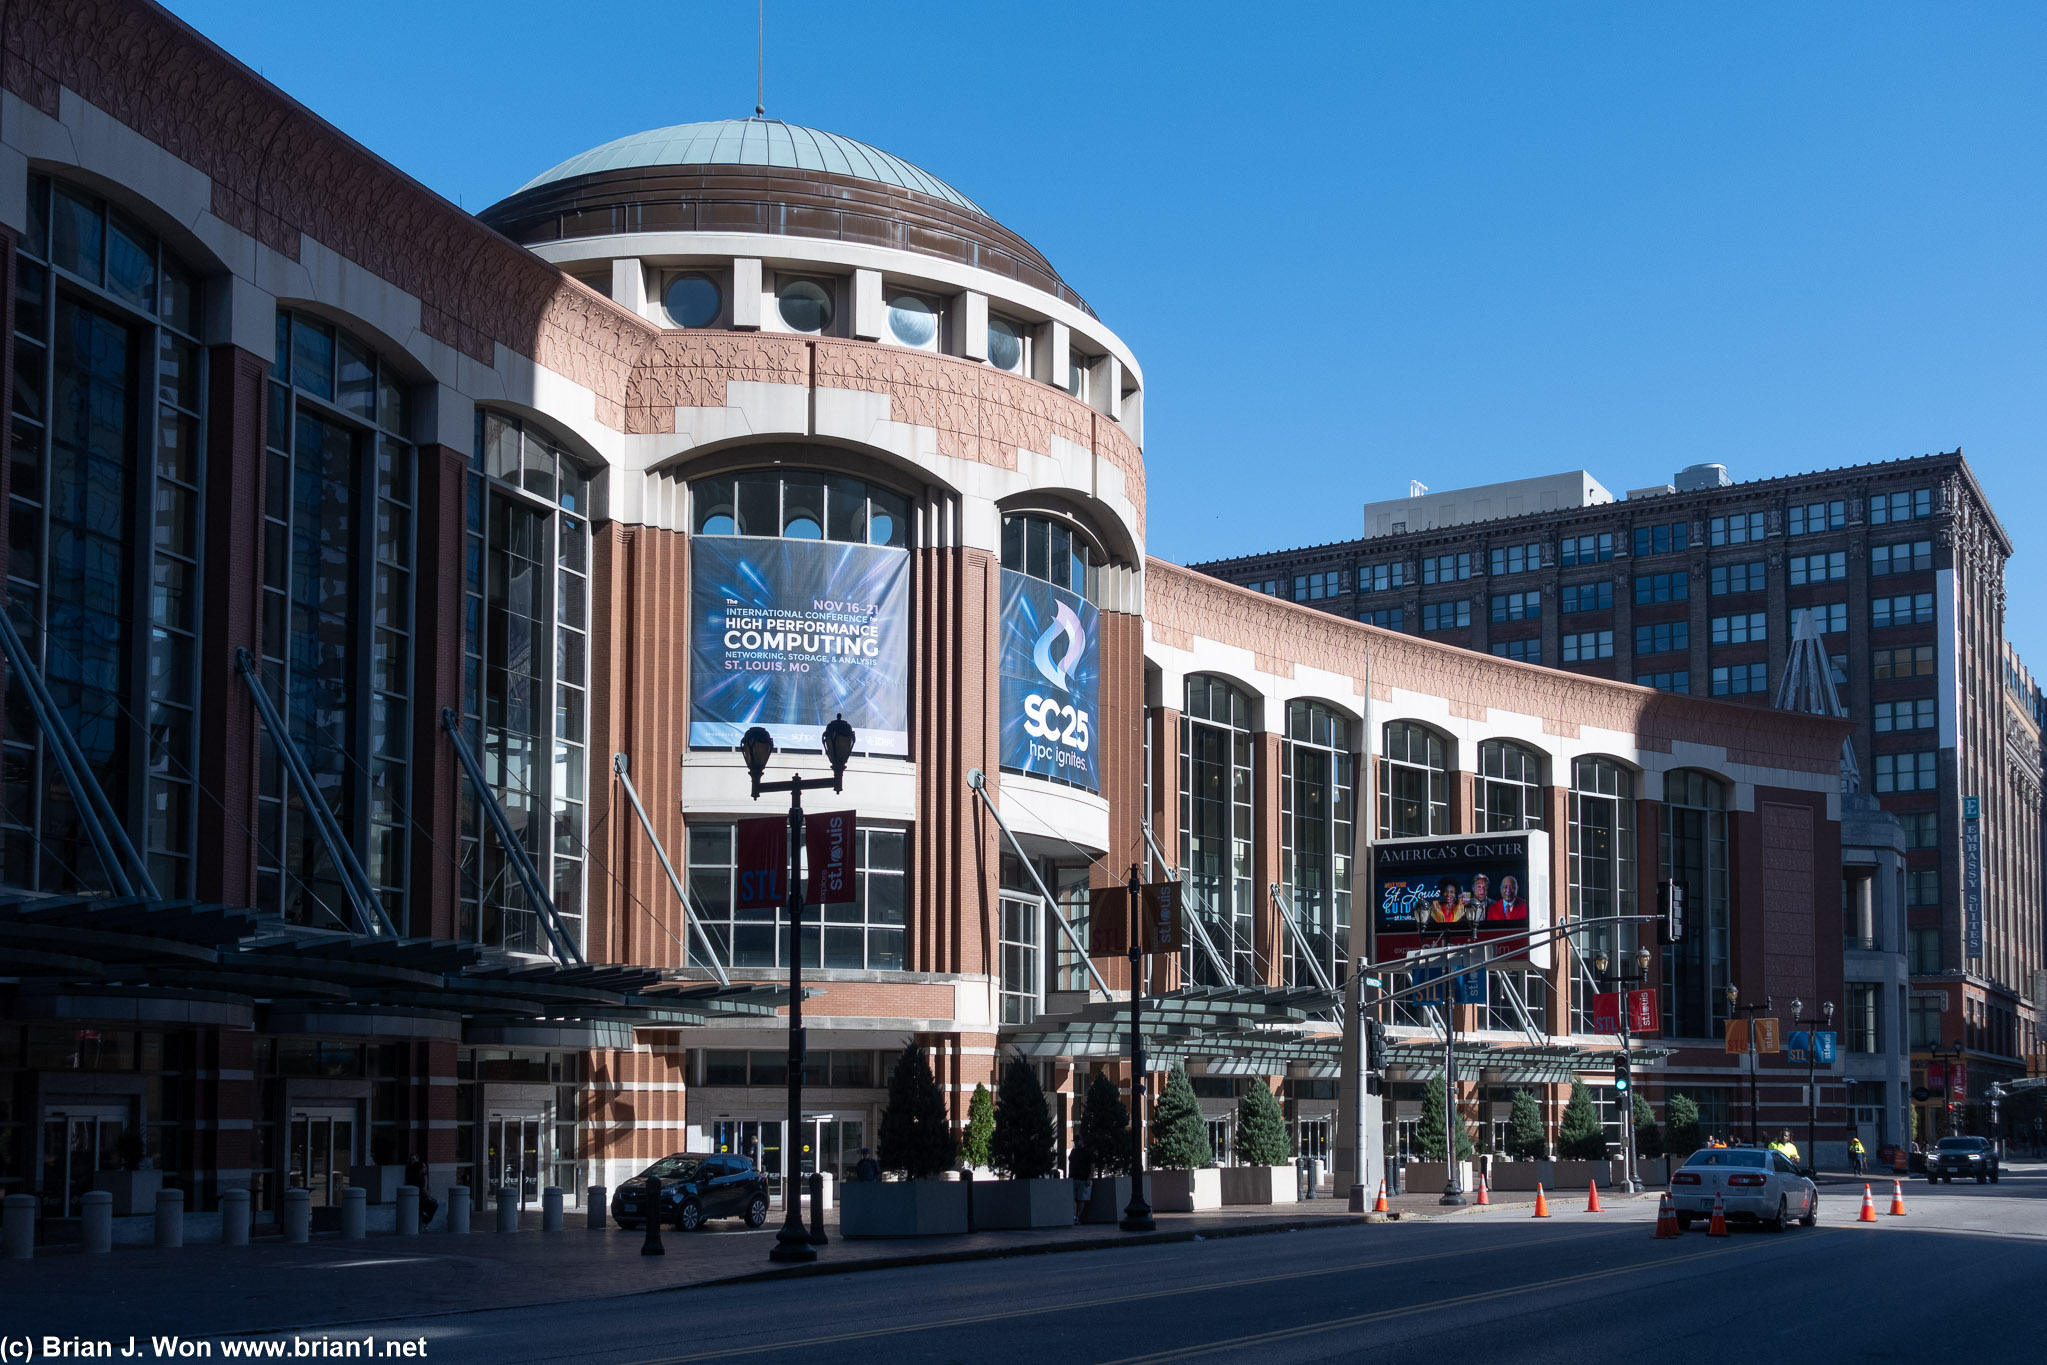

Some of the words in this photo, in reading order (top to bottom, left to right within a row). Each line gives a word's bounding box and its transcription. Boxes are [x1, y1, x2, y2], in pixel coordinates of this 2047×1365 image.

[814, 600, 843, 611] NOV
[726, 608, 803, 618] INTERNATIONAL
[805, 611, 868, 623] CONFERENCE
[725, 618, 762, 629] HIGH
[766, 619, 879, 637] PERFORMANCE
[724, 631, 879, 657] COMPUTING
[725, 651, 786, 660] NETWORKING,
[788, 653, 829, 663] STORAGE,
[838, 657, 877, 666] ANALYSIS
[725, 660, 742, 669] ST.
[745, 661, 786, 672] LOUIS,
[789, 663, 810, 673] MO
[1023, 694, 1089, 752] SC25
[1029, 740, 1053, 761] hpc
[1055, 746, 1088, 772] ignites.
[1464, 843, 1523, 858] CENTER
[1966, 825, 1978, 888] EMBASSY
[741, 869, 782, 902] STL
[1401, 884, 1441, 905] Louis
[1385, 902, 1417, 914] GUID
[1968, 894, 1980, 948] SUITES
[1596, 1015, 1618, 1032] STL
[1790, 1049, 1806, 1060] STL
